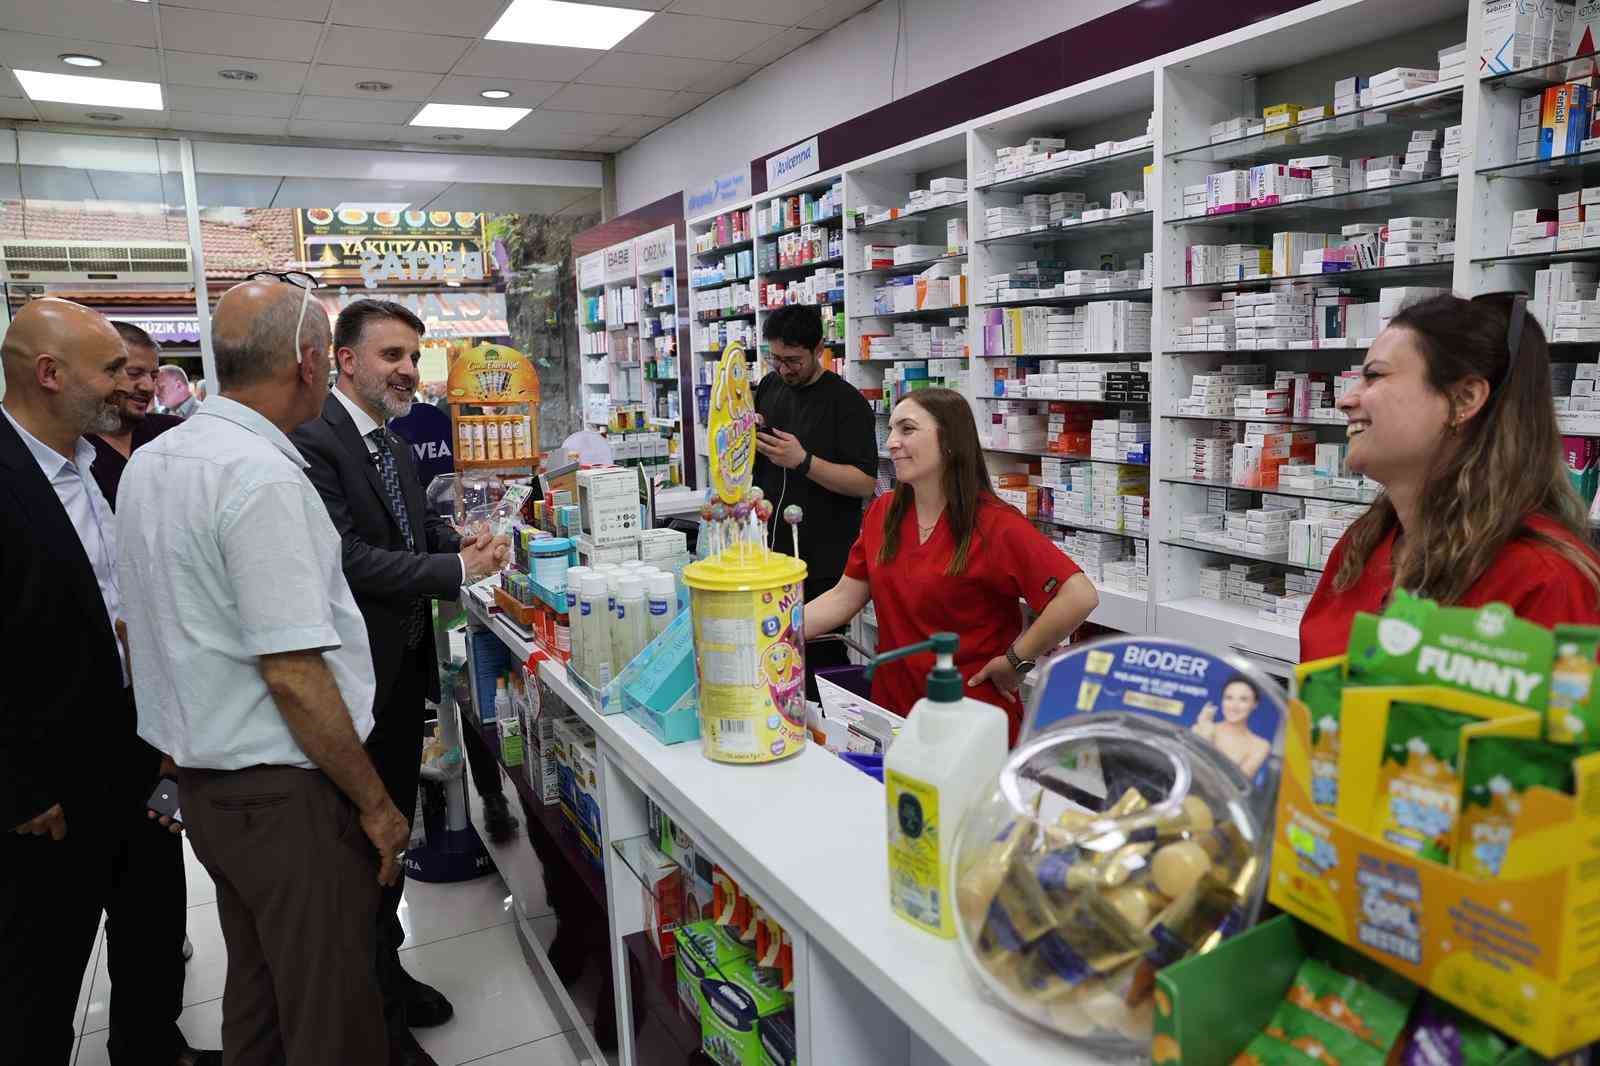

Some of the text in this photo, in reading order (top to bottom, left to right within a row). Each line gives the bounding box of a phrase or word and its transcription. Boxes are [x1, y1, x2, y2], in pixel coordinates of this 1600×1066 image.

[776, 144, 812, 177] Avicenna
[412, 439, 452, 461] VEA
[1122, 645, 1209, 680] BIODER
[1416, 644, 1544, 704] FUNNY
